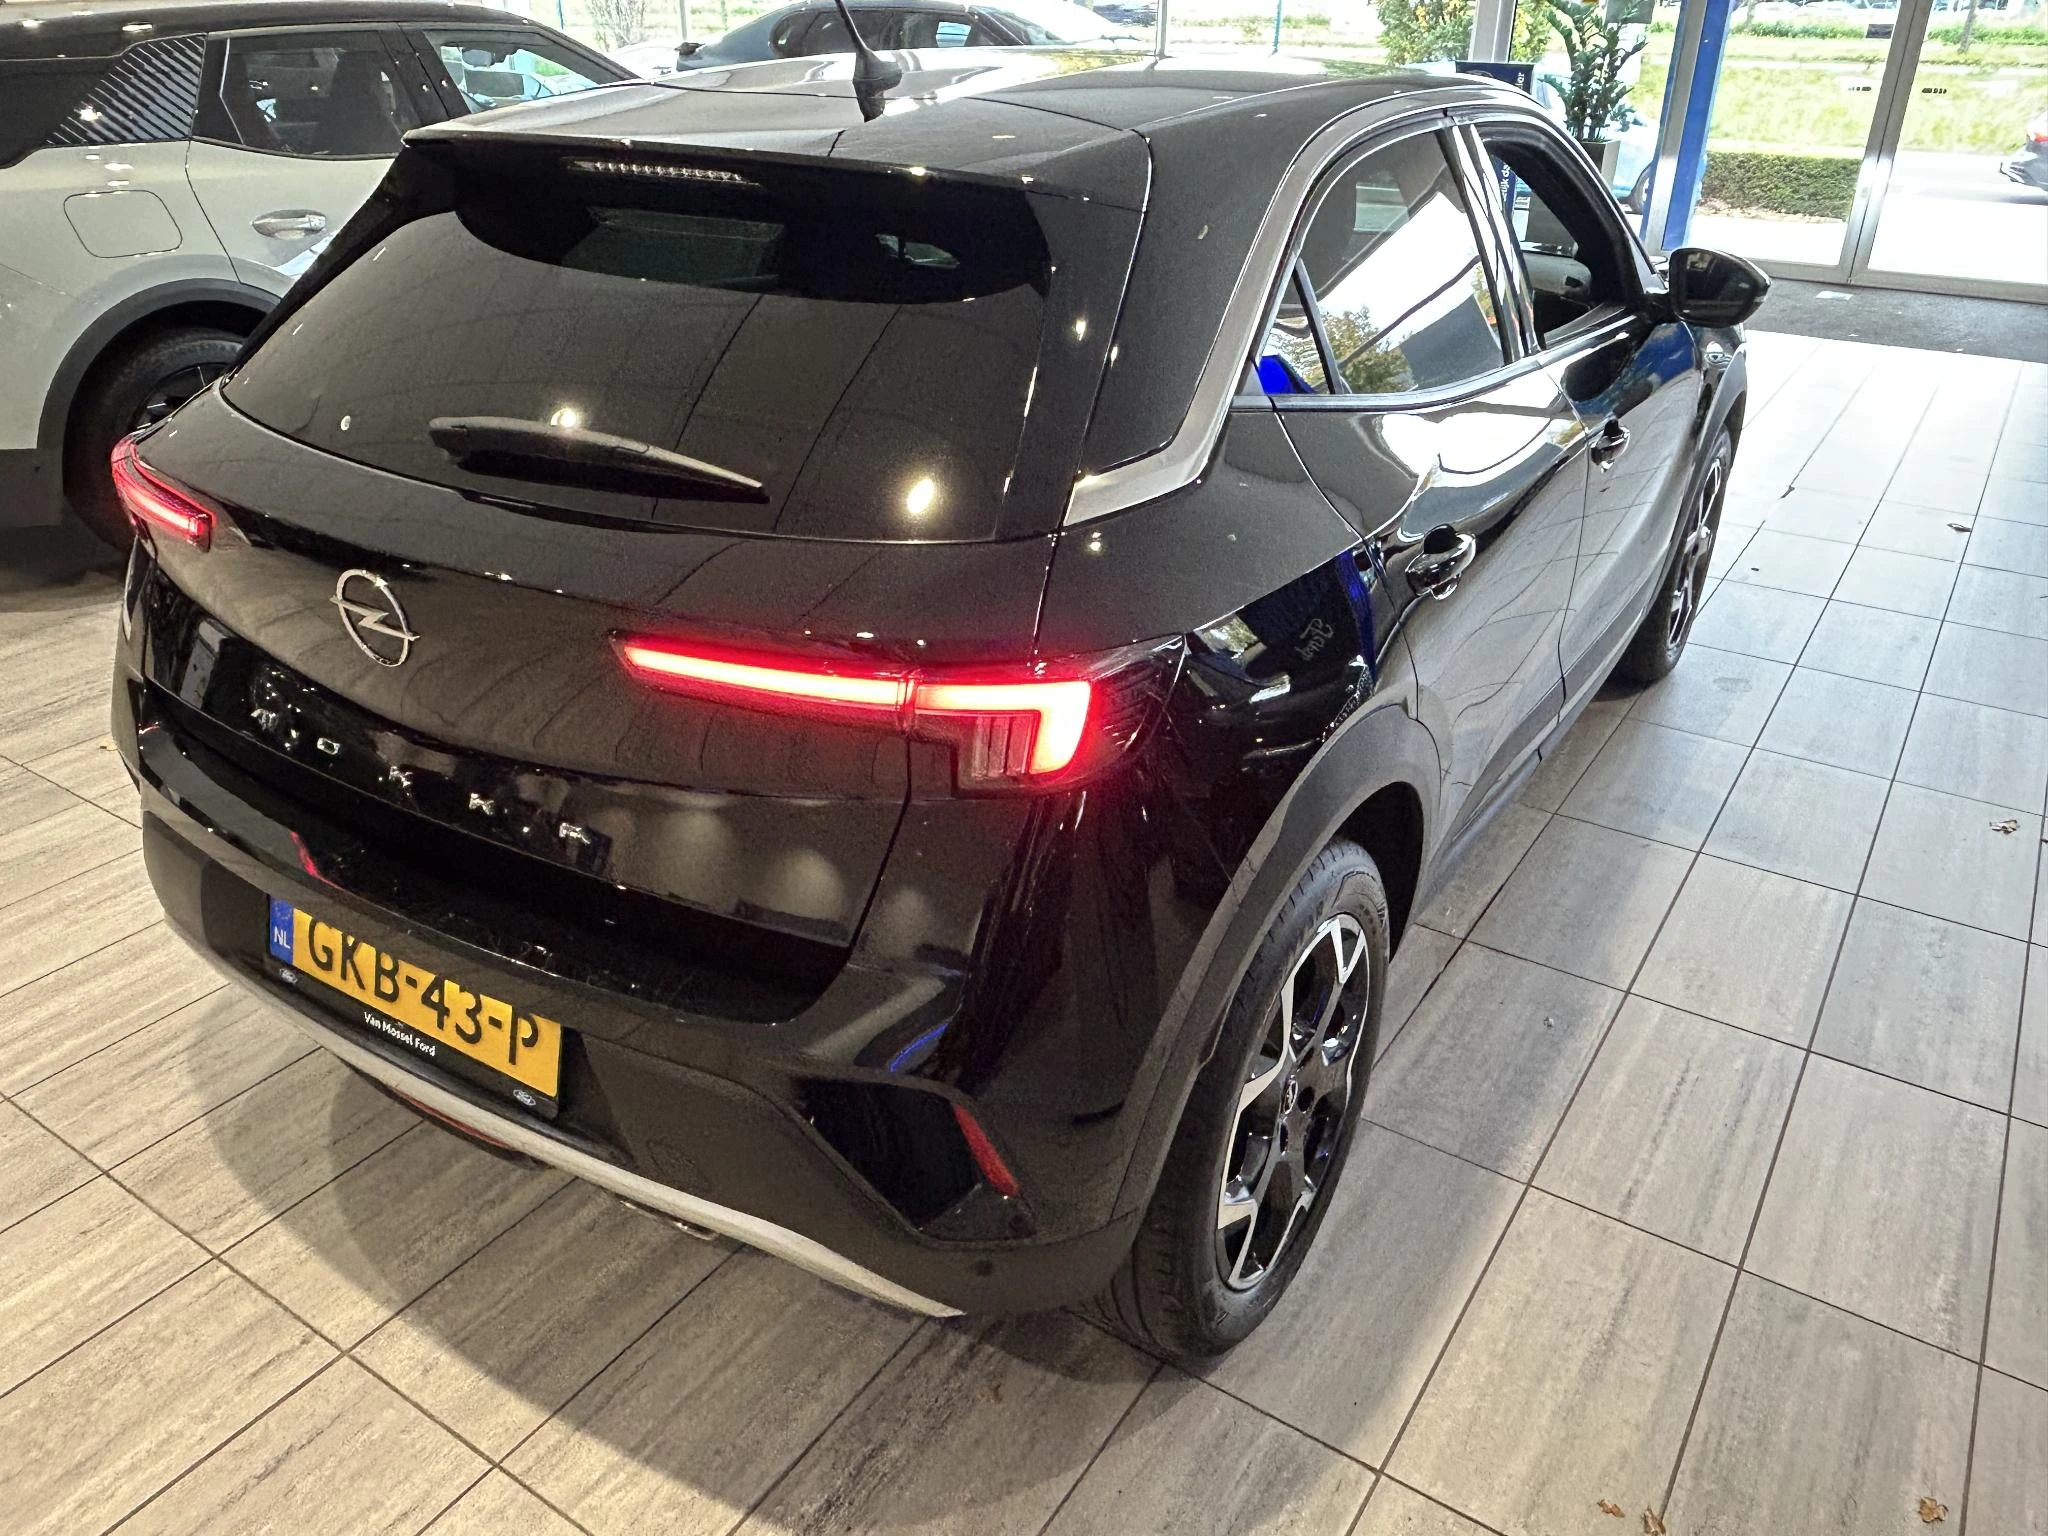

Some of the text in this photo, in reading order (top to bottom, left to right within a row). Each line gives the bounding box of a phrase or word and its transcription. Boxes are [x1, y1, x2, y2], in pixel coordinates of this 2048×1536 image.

[273, 915, 539, 1066] NL GKB-43-P
[363, 1010, 436, 1057] Van Mossel Ford
